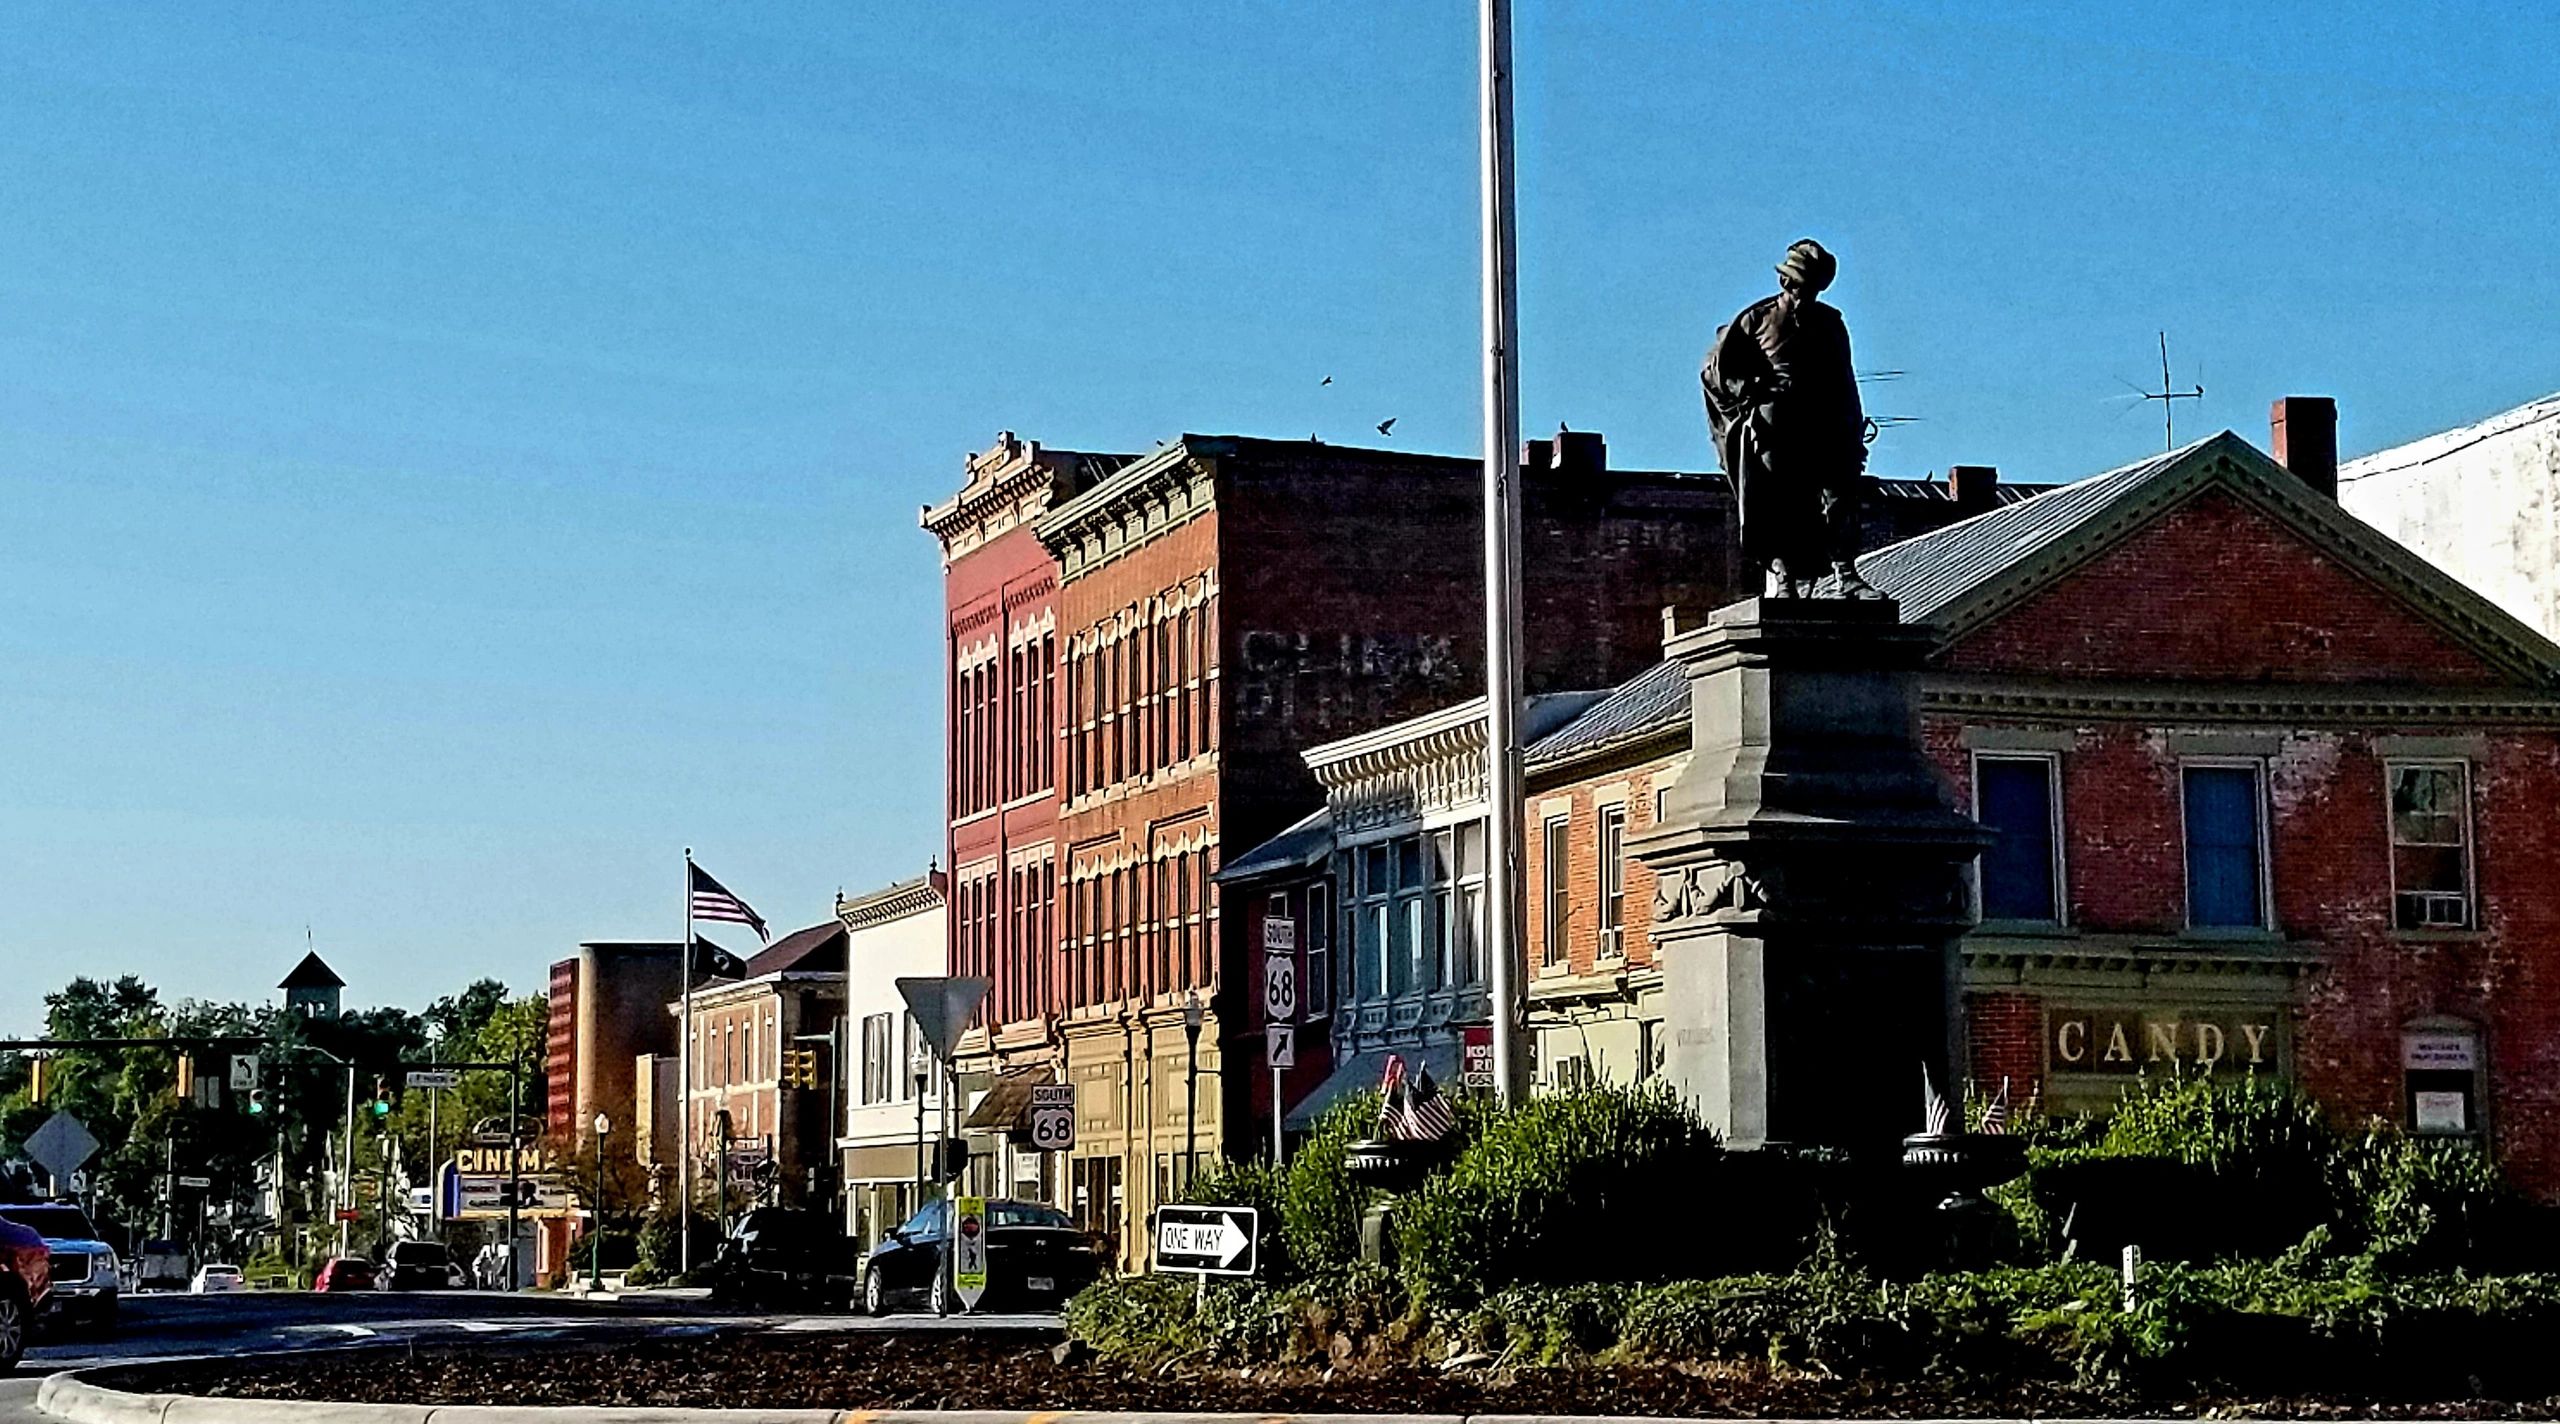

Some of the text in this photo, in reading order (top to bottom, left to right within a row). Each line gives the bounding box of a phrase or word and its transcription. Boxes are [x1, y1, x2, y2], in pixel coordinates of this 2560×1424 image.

[1268, 970, 1293, 1008] 68
[2057, 1021, 2270, 1064] CANDY
[1034, 1088, 1073, 1102] SOUTH
[1037, 1116, 1071, 1141] 68
[1165, 1227, 1224, 1251] ONE WAY
